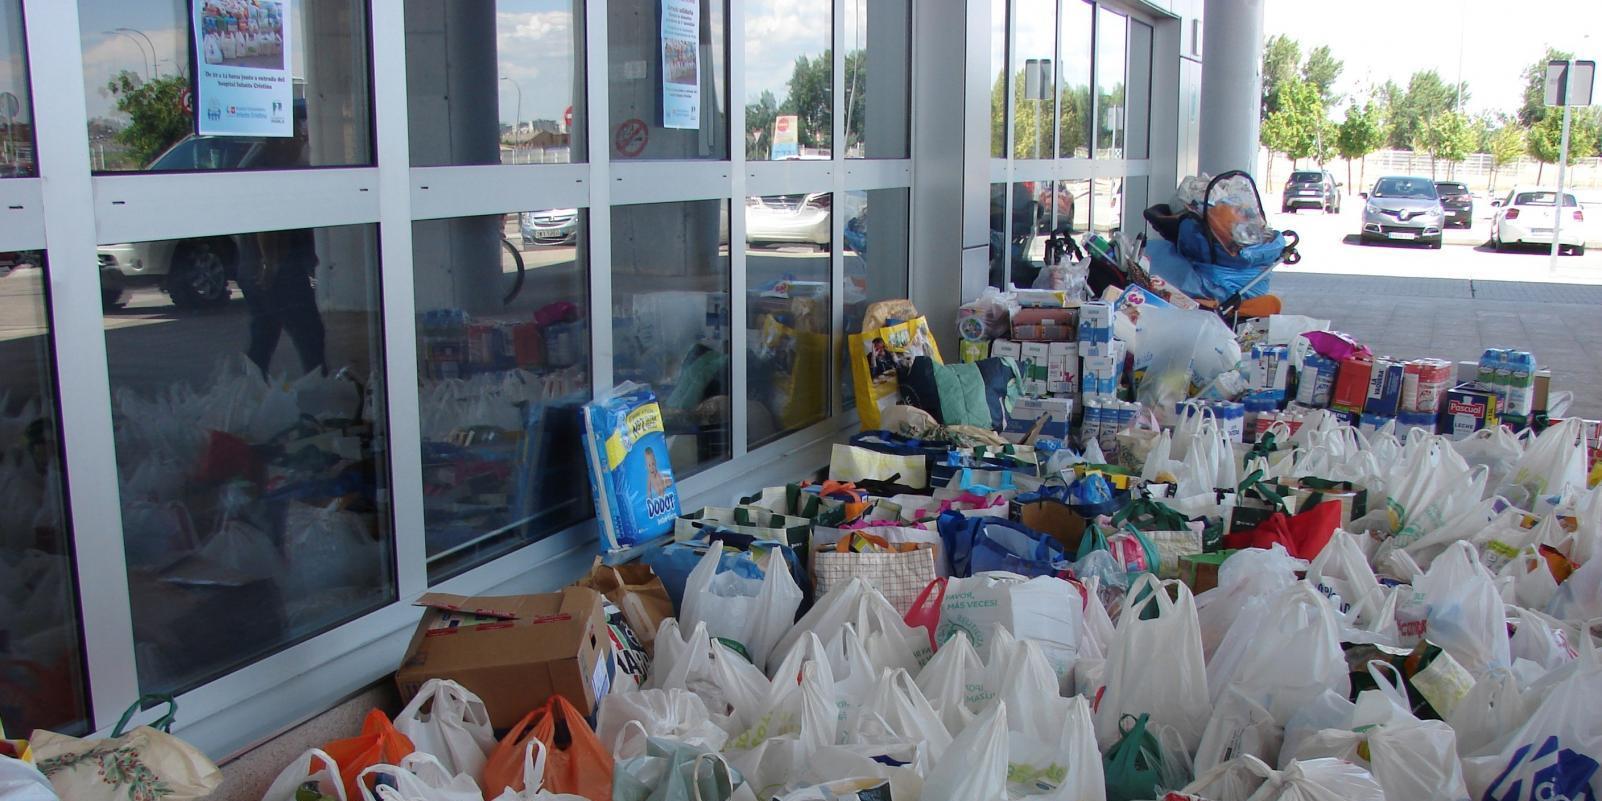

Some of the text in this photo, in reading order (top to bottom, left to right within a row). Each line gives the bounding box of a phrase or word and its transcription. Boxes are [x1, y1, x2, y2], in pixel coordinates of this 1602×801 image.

[1371, 378, 1377, 386] LA
[1450, 402, 1481, 414] Pascual
[1455, 422, 1474, 430] LECHE
[646, 493, 675, 518] DODOT
